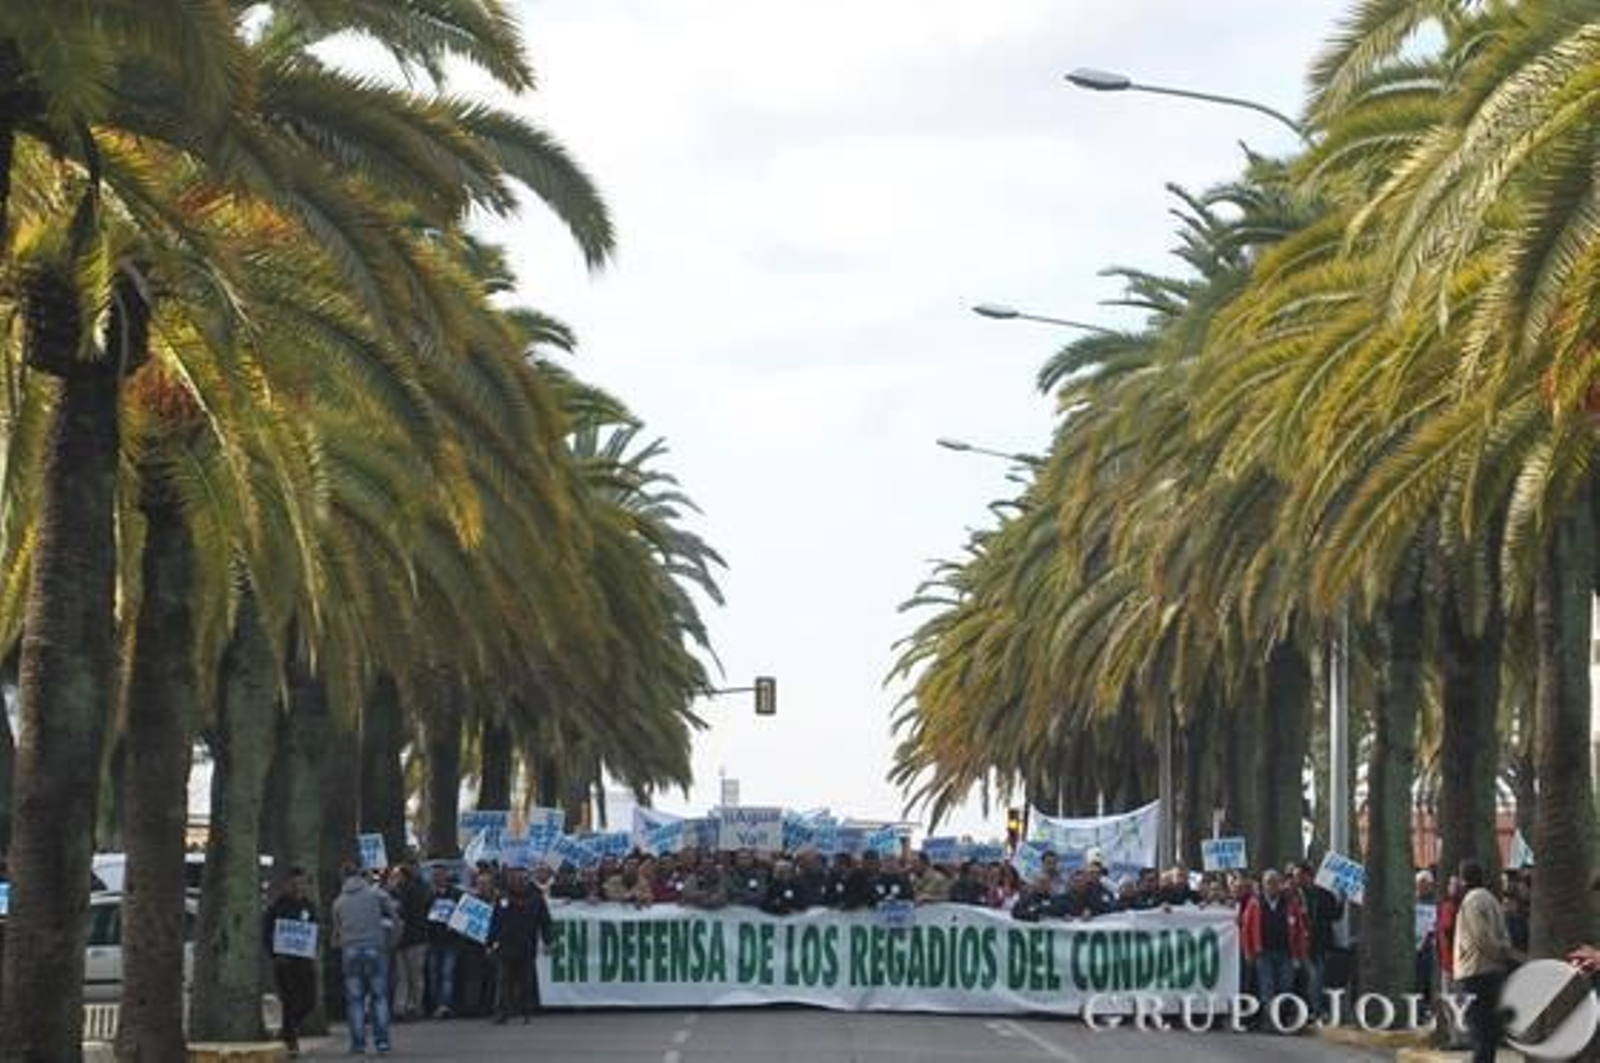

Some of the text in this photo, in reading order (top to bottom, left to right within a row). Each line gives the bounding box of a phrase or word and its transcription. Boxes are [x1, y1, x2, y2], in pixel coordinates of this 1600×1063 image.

[551, 917, 1221, 991] EN DEFENSA DE LOS REGADÍOS DEL CONDADO
